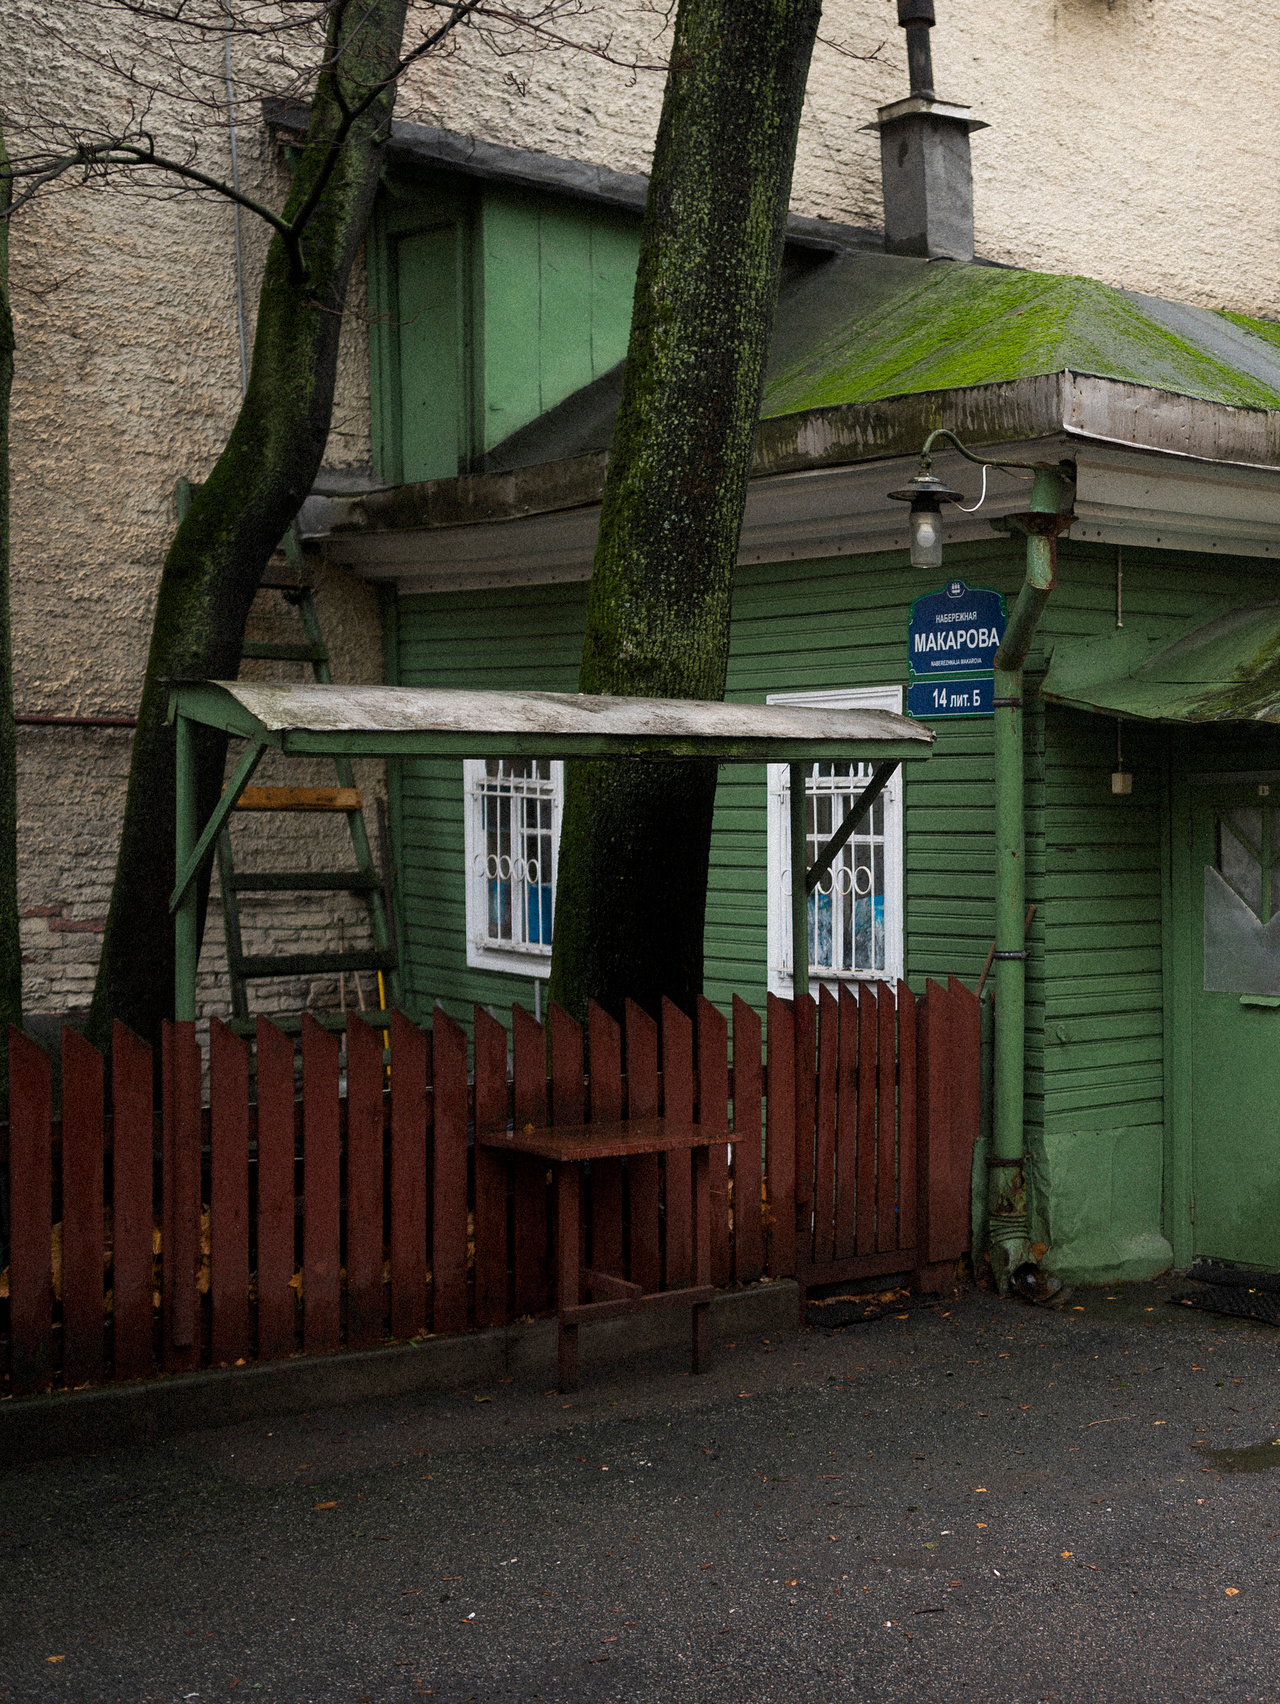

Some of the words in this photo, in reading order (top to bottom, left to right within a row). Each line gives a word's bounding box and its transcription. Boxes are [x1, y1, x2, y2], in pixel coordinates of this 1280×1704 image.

[935, 611, 978, 623] НАБЕРЕЖНАЯ
[914, 627, 1000, 652] МАКАРОВА
[932, 687, 947, 708] 14
[949, 693, 971, 708] лит.
[972, 689, 981, 707] Б
